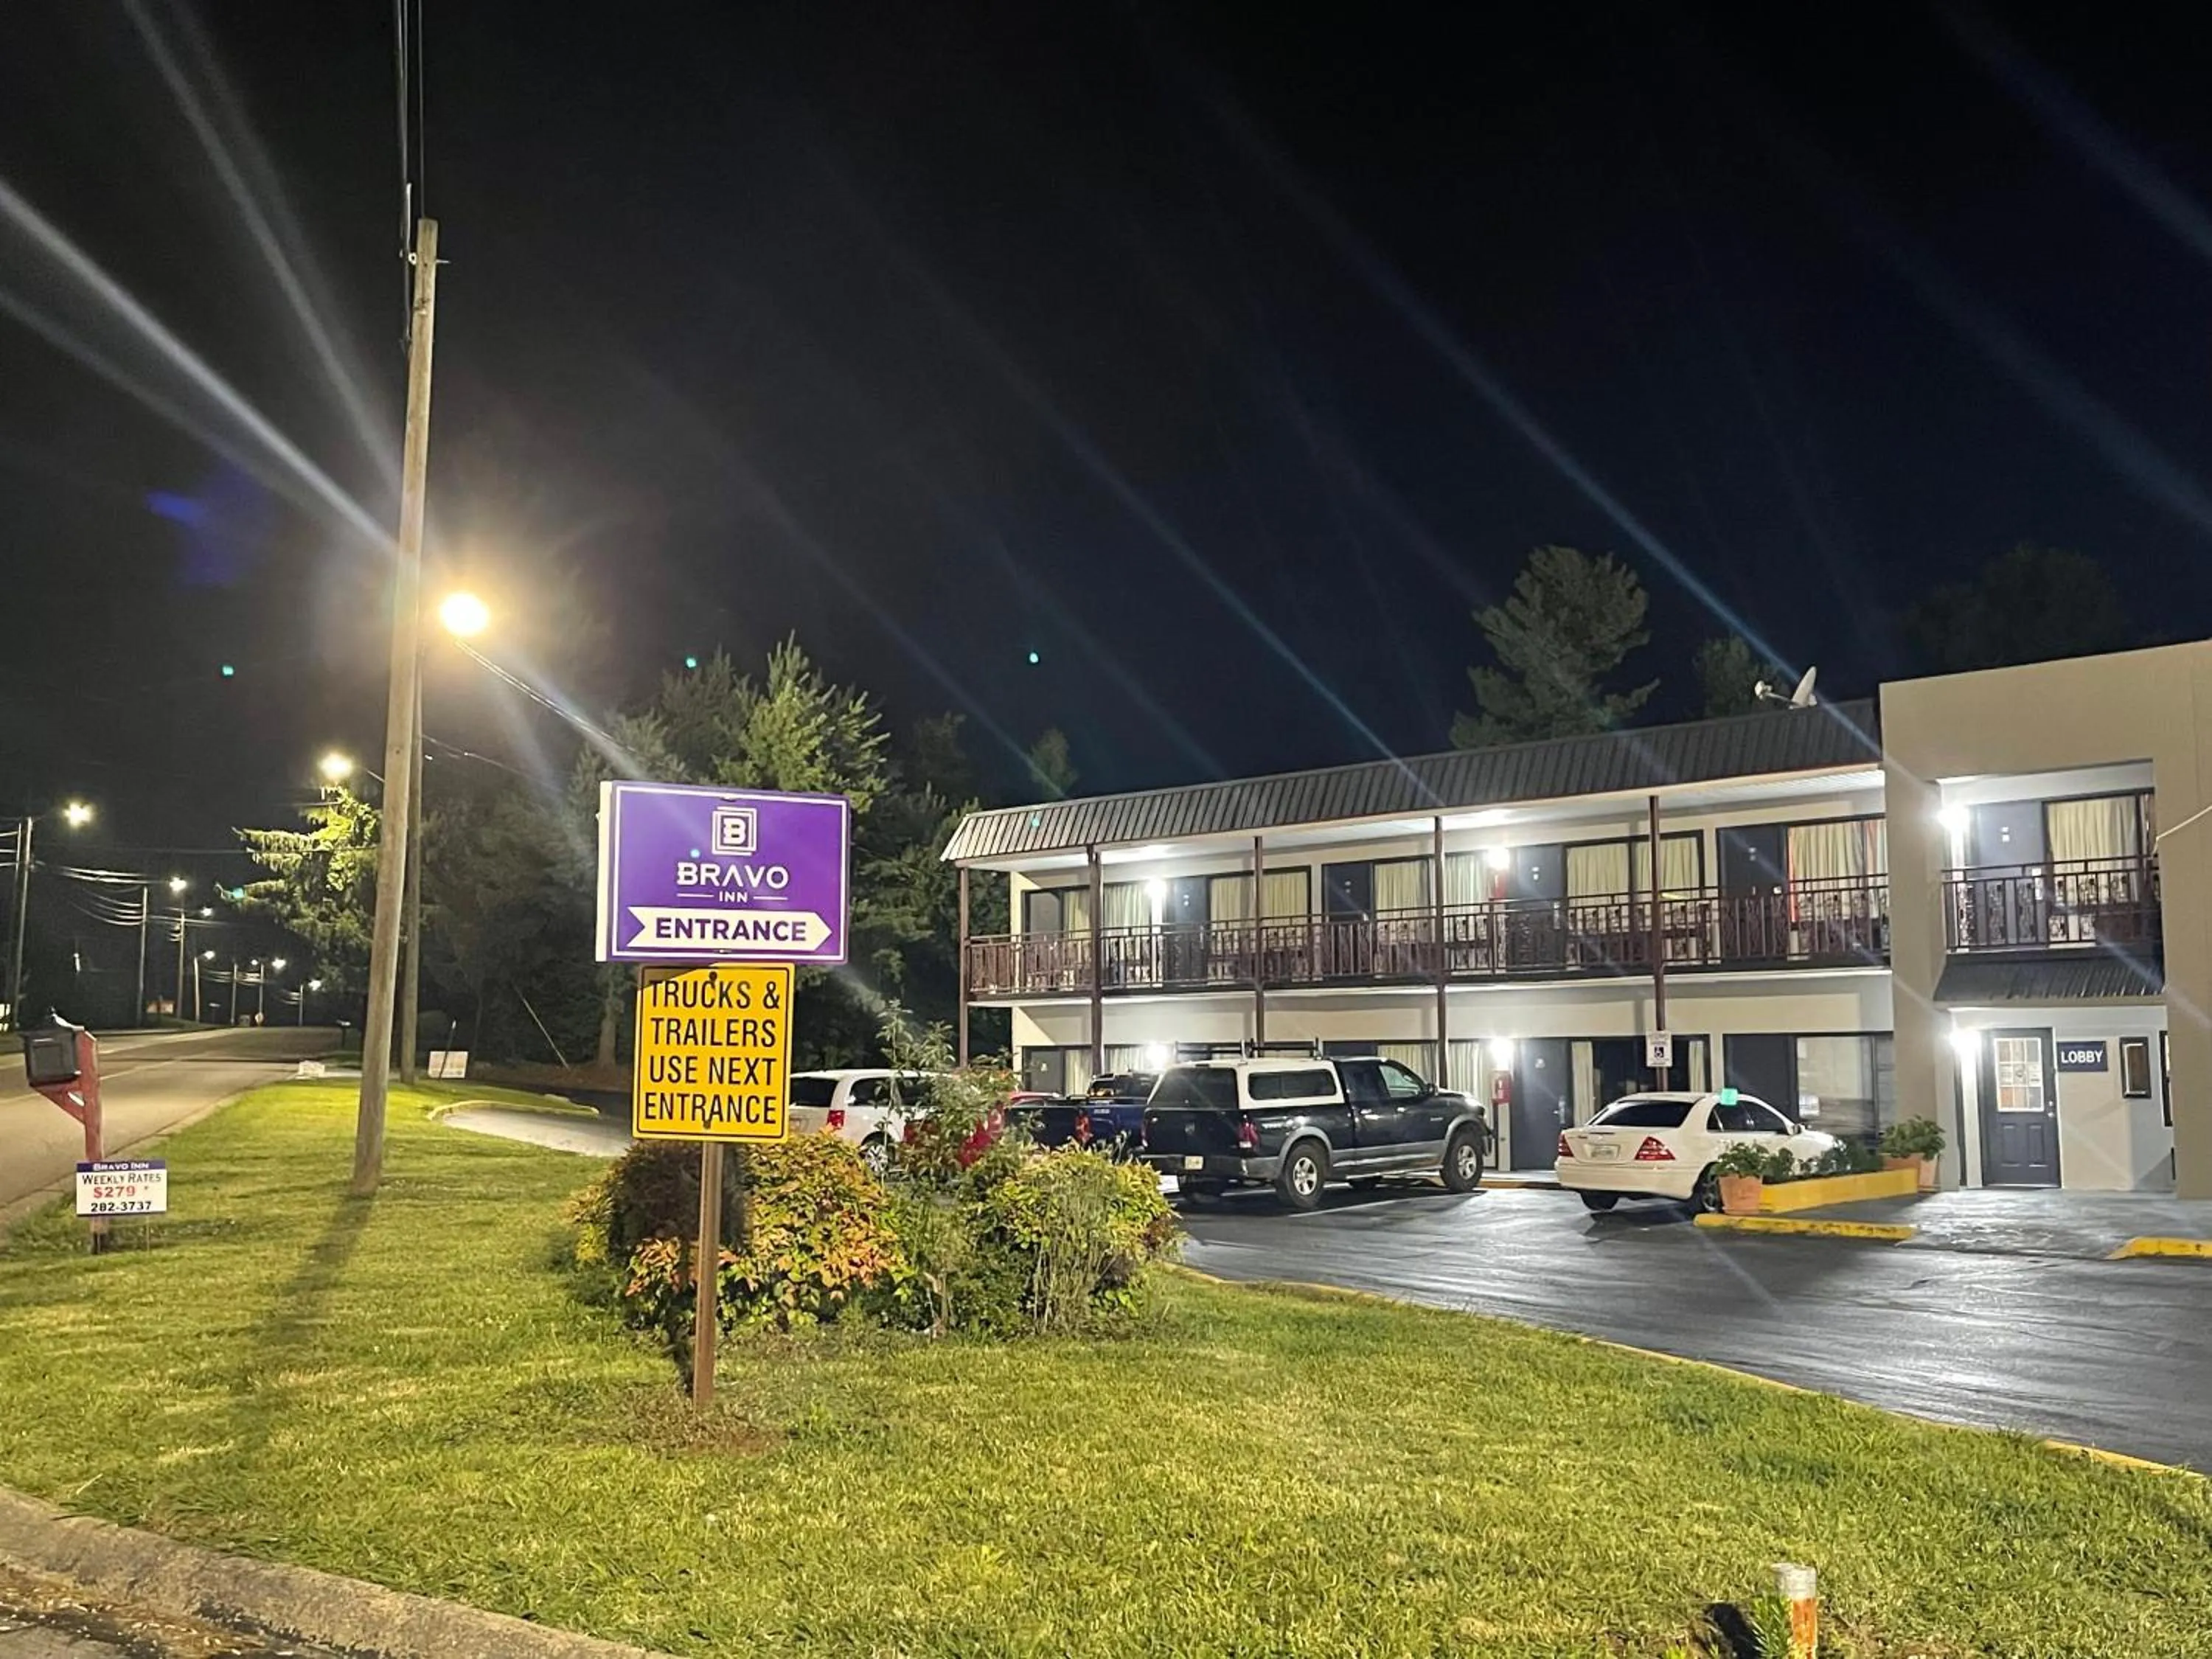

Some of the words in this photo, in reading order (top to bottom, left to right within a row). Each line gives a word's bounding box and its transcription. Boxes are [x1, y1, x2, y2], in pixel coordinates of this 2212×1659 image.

[723, 818, 745, 844] B
[677, 862, 789, 888] BRAVO
[719, 891, 748, 903] INN
[655, 917, 806, 942] ENTRANCE
[649, 980, 751, 1009] TRUCKS
[762, 981, 779, 1009] &
[650, 1018, 776, 1047] TRAILERS
[2061, 1050, 2103, 1064] LOBBY
[650, 1055, 698, 1084] USE
[709, 1057, 777, 1085] NEXT
[645, 1092, 776, 1124] ENTRANCE
[82, 1175, 125, 1185] WEEKLY
[128, 1172, 161, 1183] RATES
[93, 1163, 128, 1171] BRAVO
[91, 1201, 152, 1212] 282-3737
